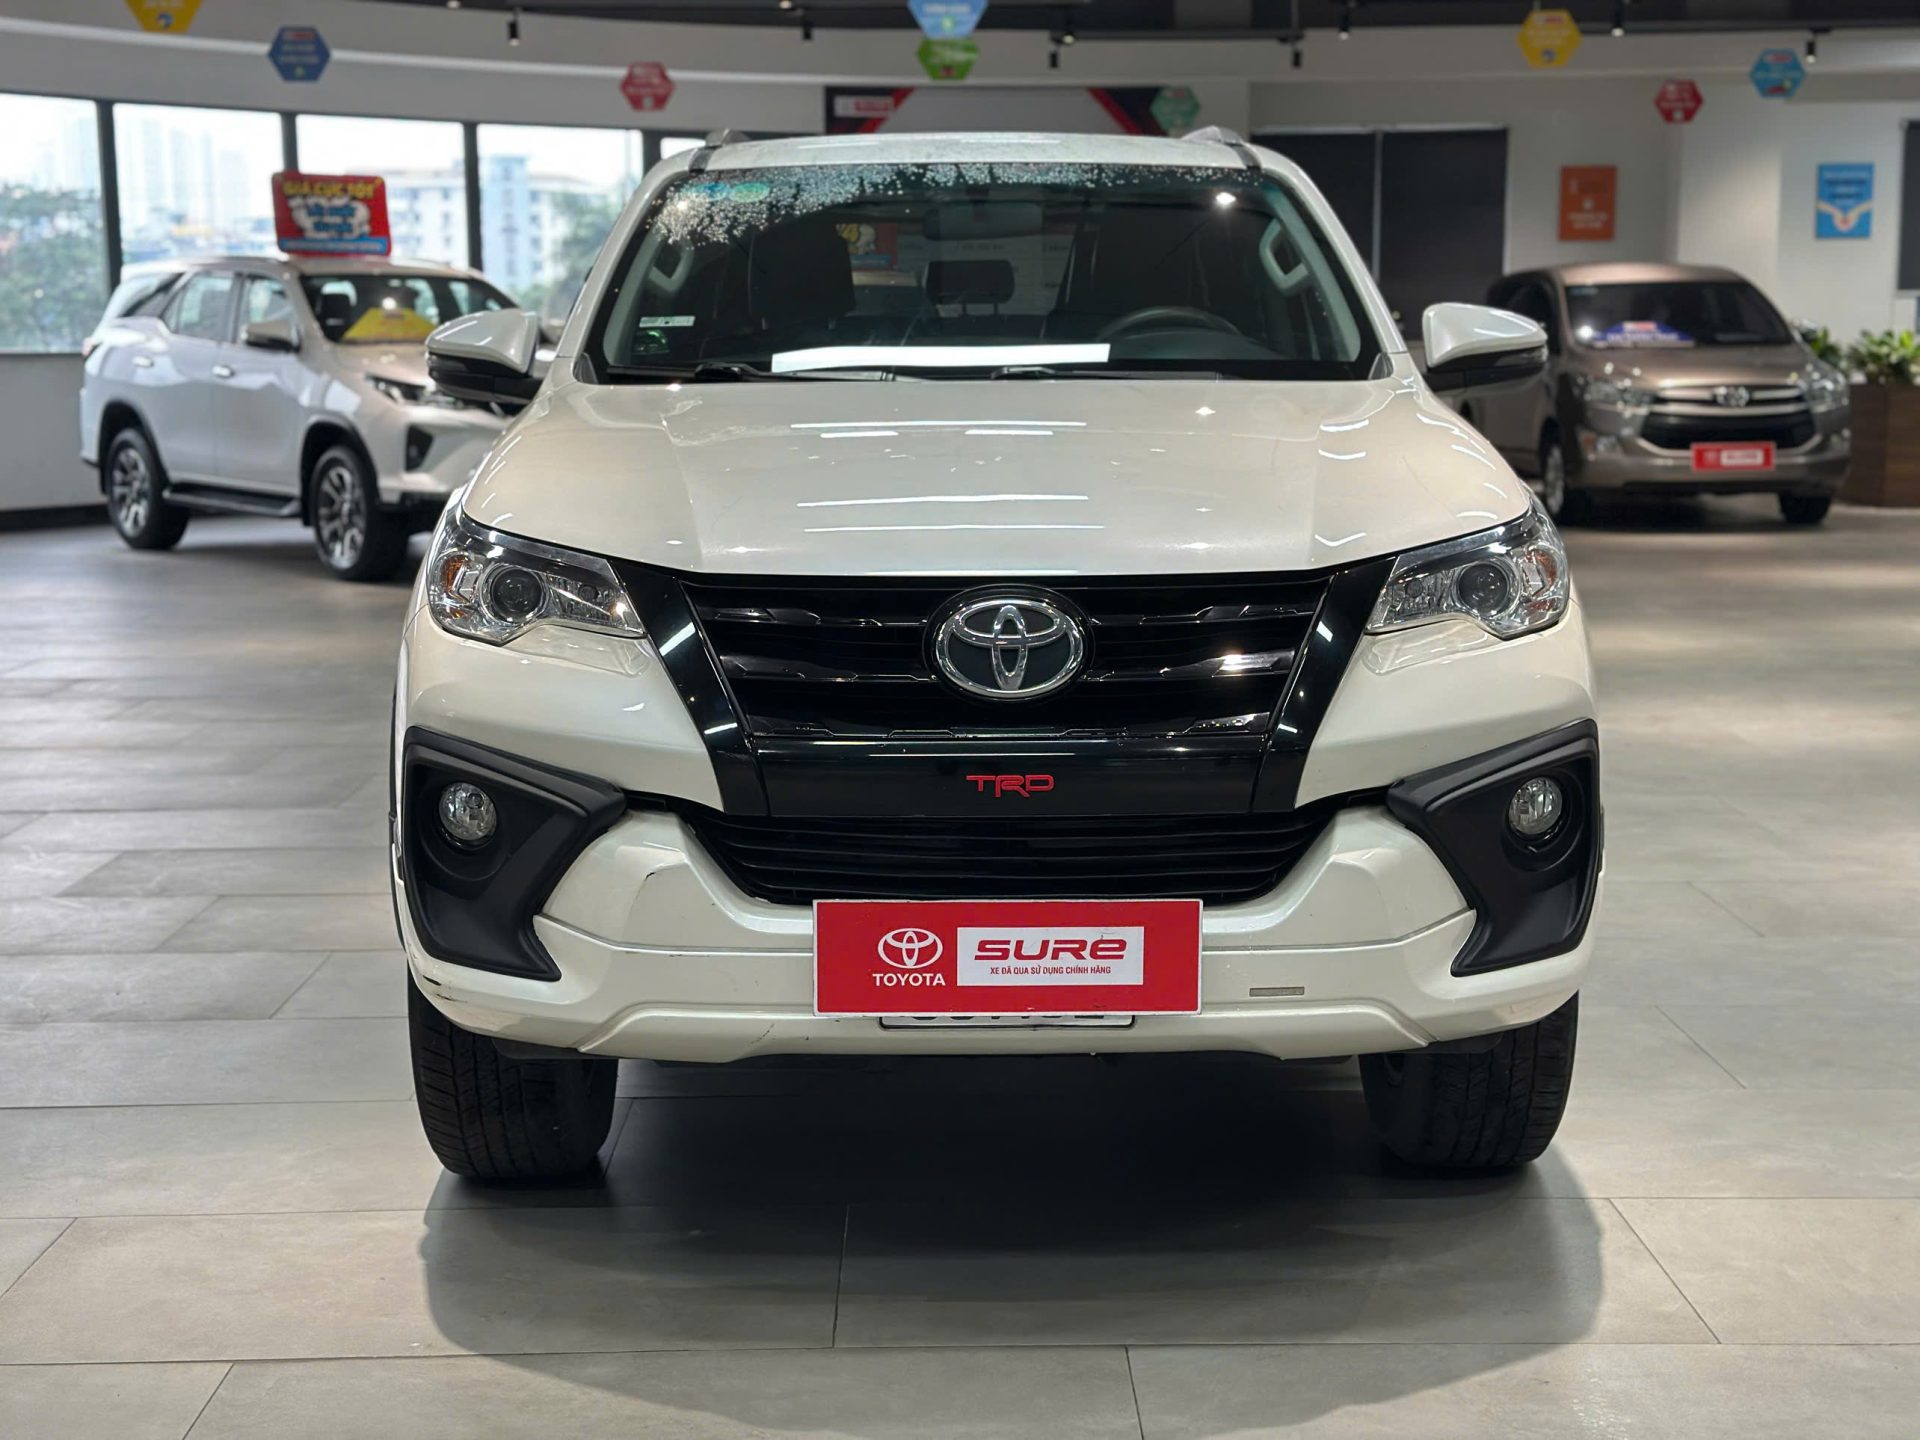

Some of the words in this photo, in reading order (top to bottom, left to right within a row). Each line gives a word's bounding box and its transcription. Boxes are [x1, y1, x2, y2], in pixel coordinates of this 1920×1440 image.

[966, 774, 1054, 798] TRD
[990, 966, 1000, 975] XE
[1001, 965, 1012, 975] ĐÃ
[1013, 966, 1029, 975] QUA
[1030, 964, 1041, 975] SỬ
[1042, 966, 1064, 977] DỤNG
[1065, 964, 1089, 975] CHÍNH
[872, 973, 946, 987] TOYOTA
